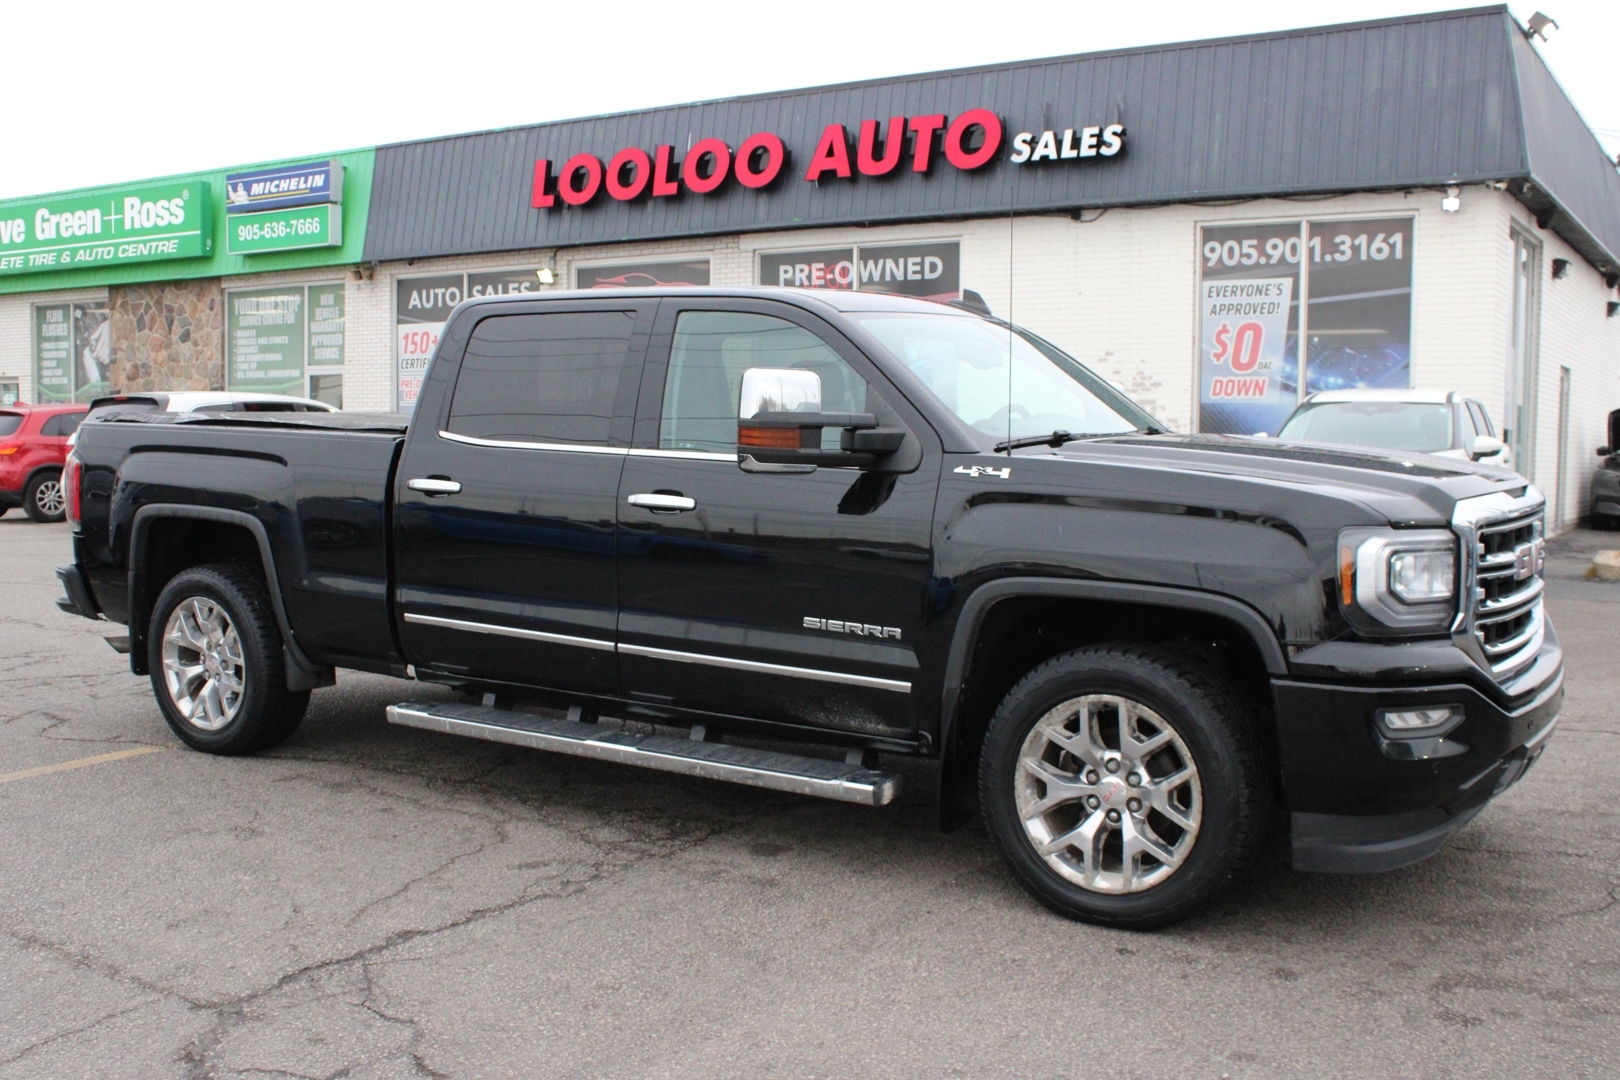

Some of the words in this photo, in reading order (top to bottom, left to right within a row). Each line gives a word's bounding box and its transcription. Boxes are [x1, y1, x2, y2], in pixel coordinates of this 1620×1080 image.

[531, 131, 785, 209] LOOLOO
[804, 108, 1002, 182] AUTO
[1010, 124, 1125, 164] SALES
[250, 174, 325, 196] MICHELIN
[238, 217, 320, 241] 905-636-7666
[28, 253, 57, 267] TIRE
[60, 250, 71, 263] &
[74, 246, 115, 262] AUTO
[118, 240, 179, 258] CENTRE
[1203, 232, 1404, 267] 905.901.3161
[779, 256, 943, 286] PRE-OWNED
[408, 287, 460, 309] AUTO
[1207, 283, 1284, 299] EVERYONE'S
[1209, 302, 1281, 316] APPROVED!
[1211, 321, 1264, 373] $0
[1211, 377, 1267, 398] DOWN
[803, 616, 902, 639] SIERRA
